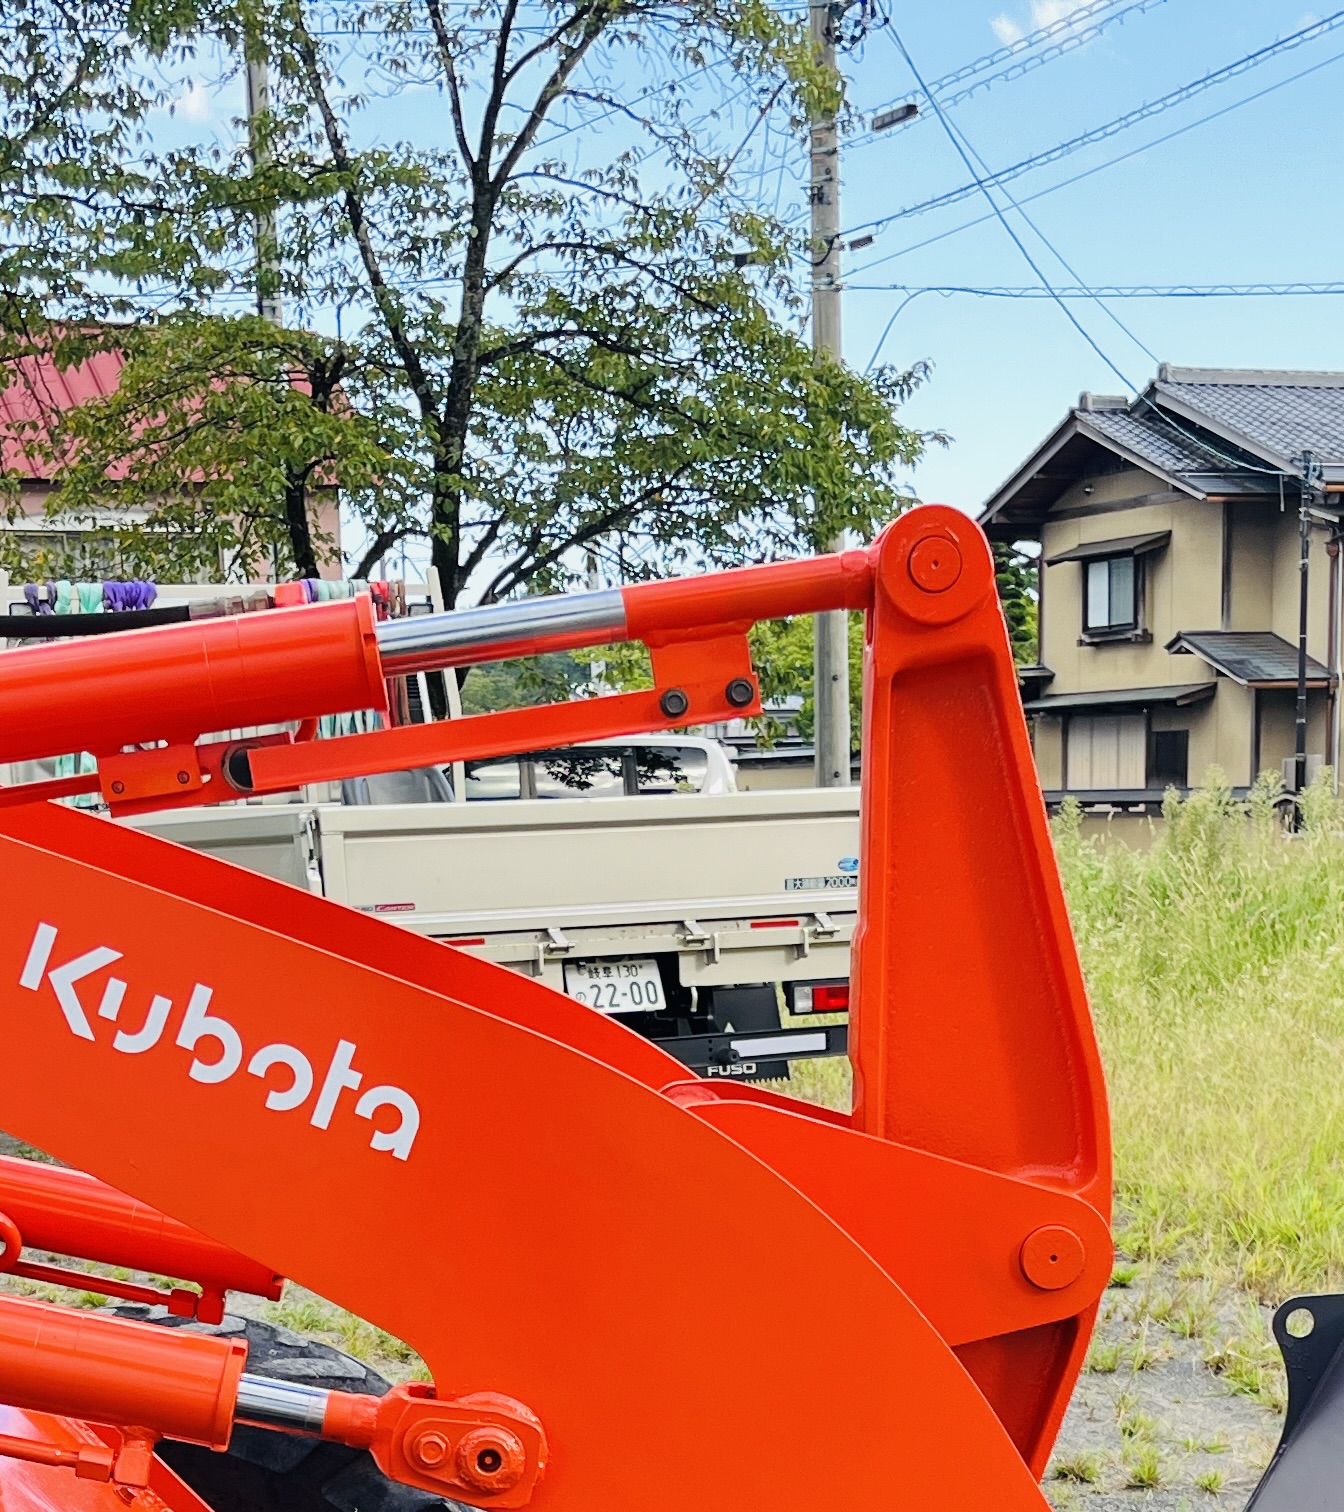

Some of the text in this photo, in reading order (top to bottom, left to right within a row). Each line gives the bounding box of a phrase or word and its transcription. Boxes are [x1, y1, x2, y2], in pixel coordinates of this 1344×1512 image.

[590, 980, 658, 1008] 22-00
[19, 922, 421, 1162] Kubota
[707, 1063, 757, 1077] FUSO
